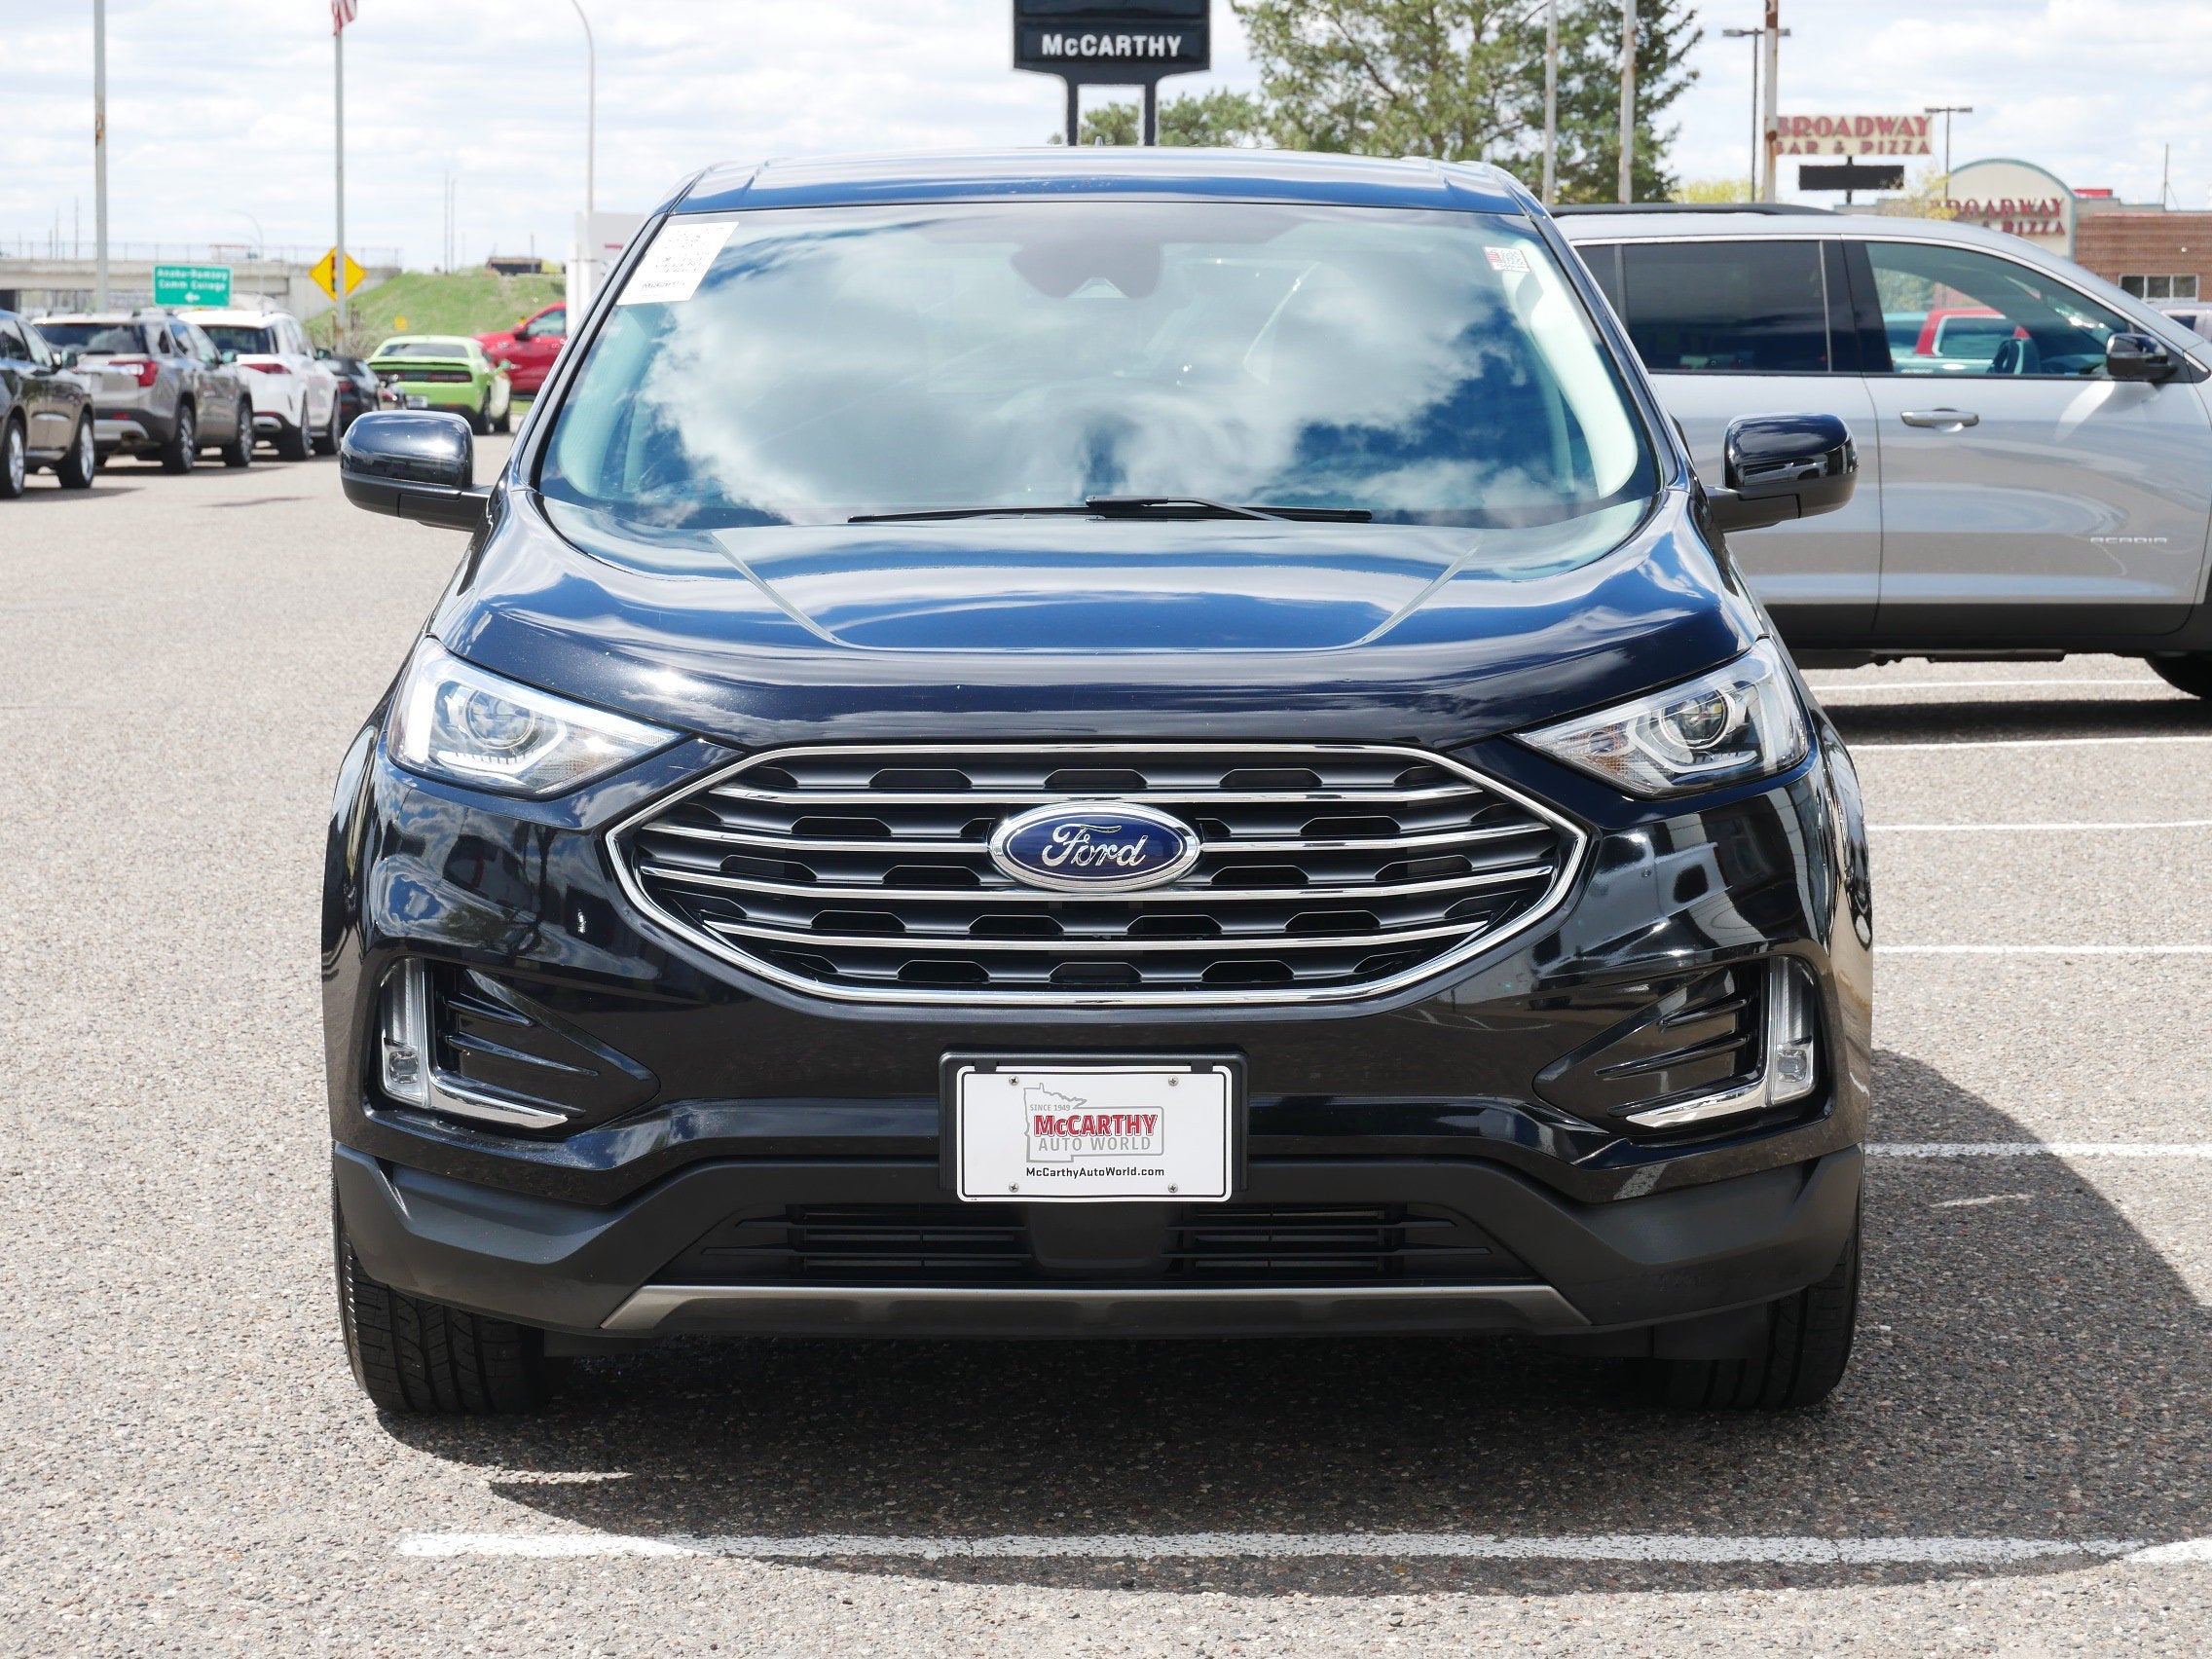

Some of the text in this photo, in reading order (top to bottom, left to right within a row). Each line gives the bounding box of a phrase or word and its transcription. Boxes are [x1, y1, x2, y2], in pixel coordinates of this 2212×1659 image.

[1042, 34, 1182, 57] McCARTHY
[1777, 116, 1931, 137] BROADWAY
[1833, 141, 1845, 155] &
[1861, 141, 1931, 155] PIZZA
[1042, 824, 1149, 866] Ford
[1033, 1114, 1158, 1137] McCARTHY
[1038, 1136, 1151, 1152] AUTO WORLD
[1026, 1166, 1164, 1179] McCarthyAutoWorld.com
